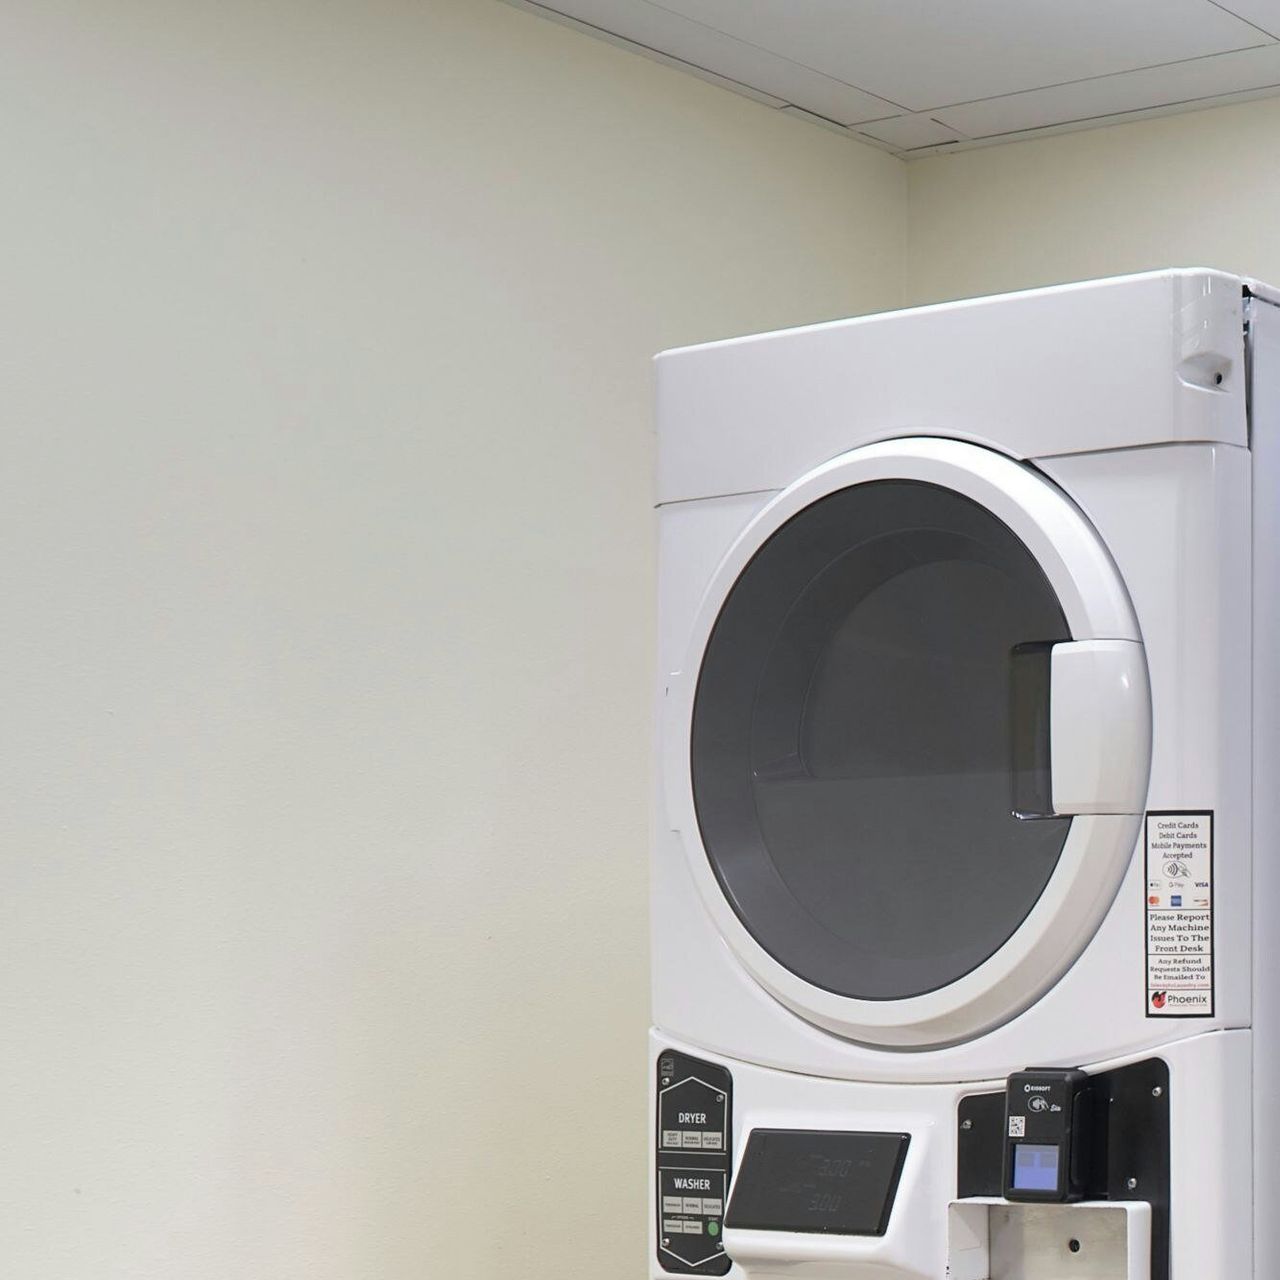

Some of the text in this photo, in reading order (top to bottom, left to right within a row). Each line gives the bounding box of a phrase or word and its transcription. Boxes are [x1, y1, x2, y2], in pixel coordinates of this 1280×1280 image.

[1177, 821, 1199, 829] Cards
[1172, 842, 1207, 850] Payments
[1163, 852, 1193, 860] Accepted
[1176, 914, 1210, 922] Report
[1150, 934, 1210, 942] Issues To The
[1167, 995, 1207, 1004] Phoenix
[678, 1112, 707, 1124] DRYER
[673, 1178, 710, 1191] WASHER
